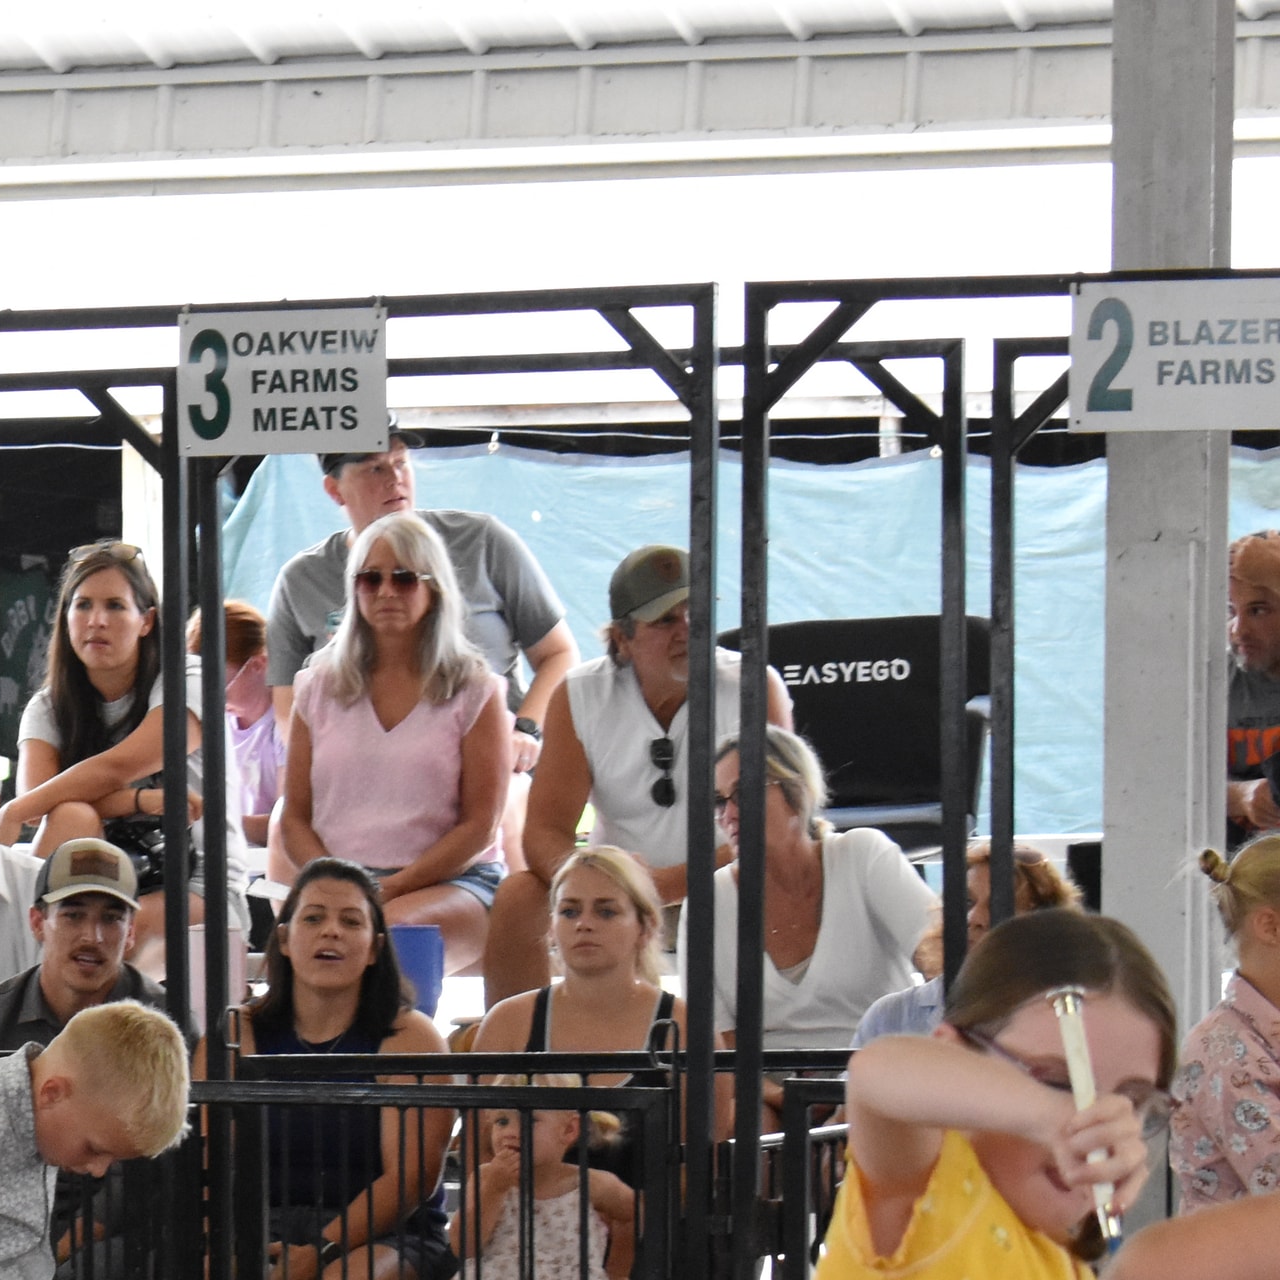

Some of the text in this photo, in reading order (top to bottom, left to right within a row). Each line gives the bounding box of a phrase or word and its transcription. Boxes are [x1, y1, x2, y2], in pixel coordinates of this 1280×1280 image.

[232, 329, 379, 357] OAKVEIW
[1148, 318, 1280, 346] BLAZER
[1086, 297, 1134, 412] 2
[188, 328, 231, 440] 3
[251, 367, 359, 394] FARMS
[1156, 358, 1276, 386] FARMS
[253, 405, 359, 432] MEATS
